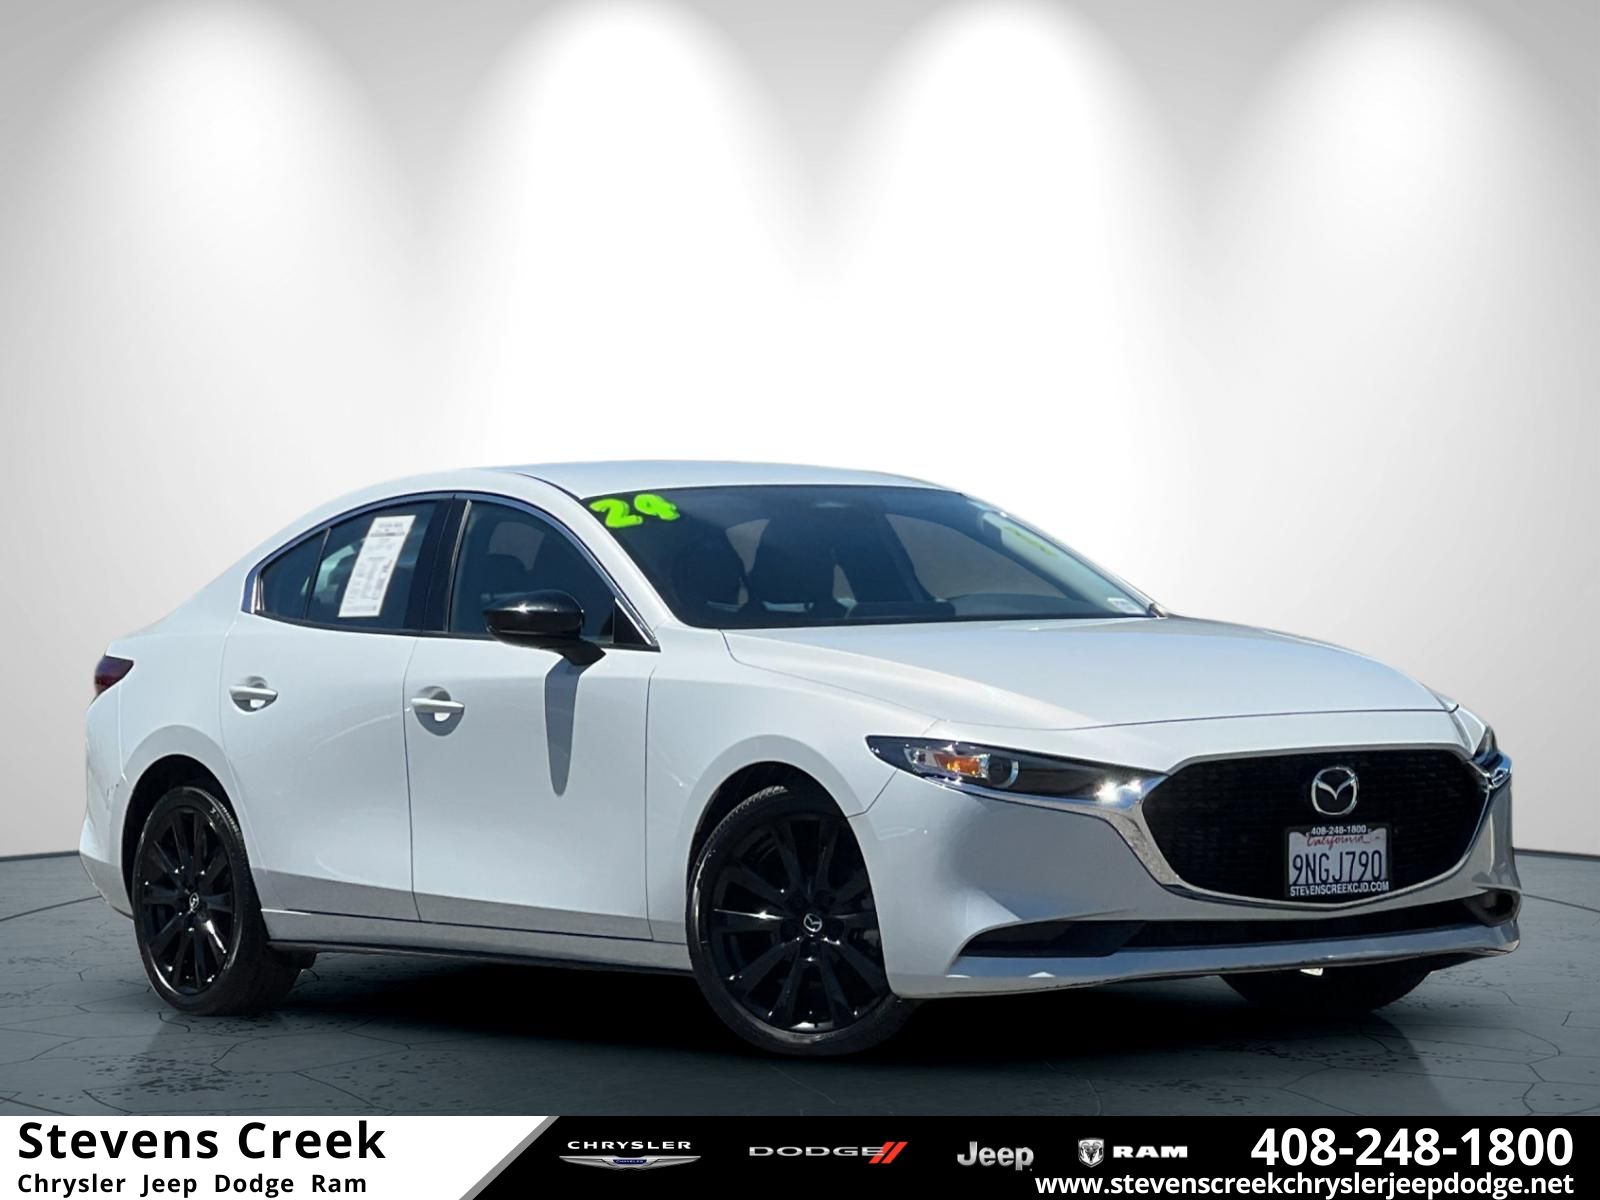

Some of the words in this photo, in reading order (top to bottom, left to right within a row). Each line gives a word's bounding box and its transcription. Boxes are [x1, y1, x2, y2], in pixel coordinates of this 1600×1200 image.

[1311, 824, 1367, 836] 408-248-1800
[1291, 849, 1382, 885] 9NGJ790
[1290, 881, 1390, 897] STEVENSCREEKCJD.COM
